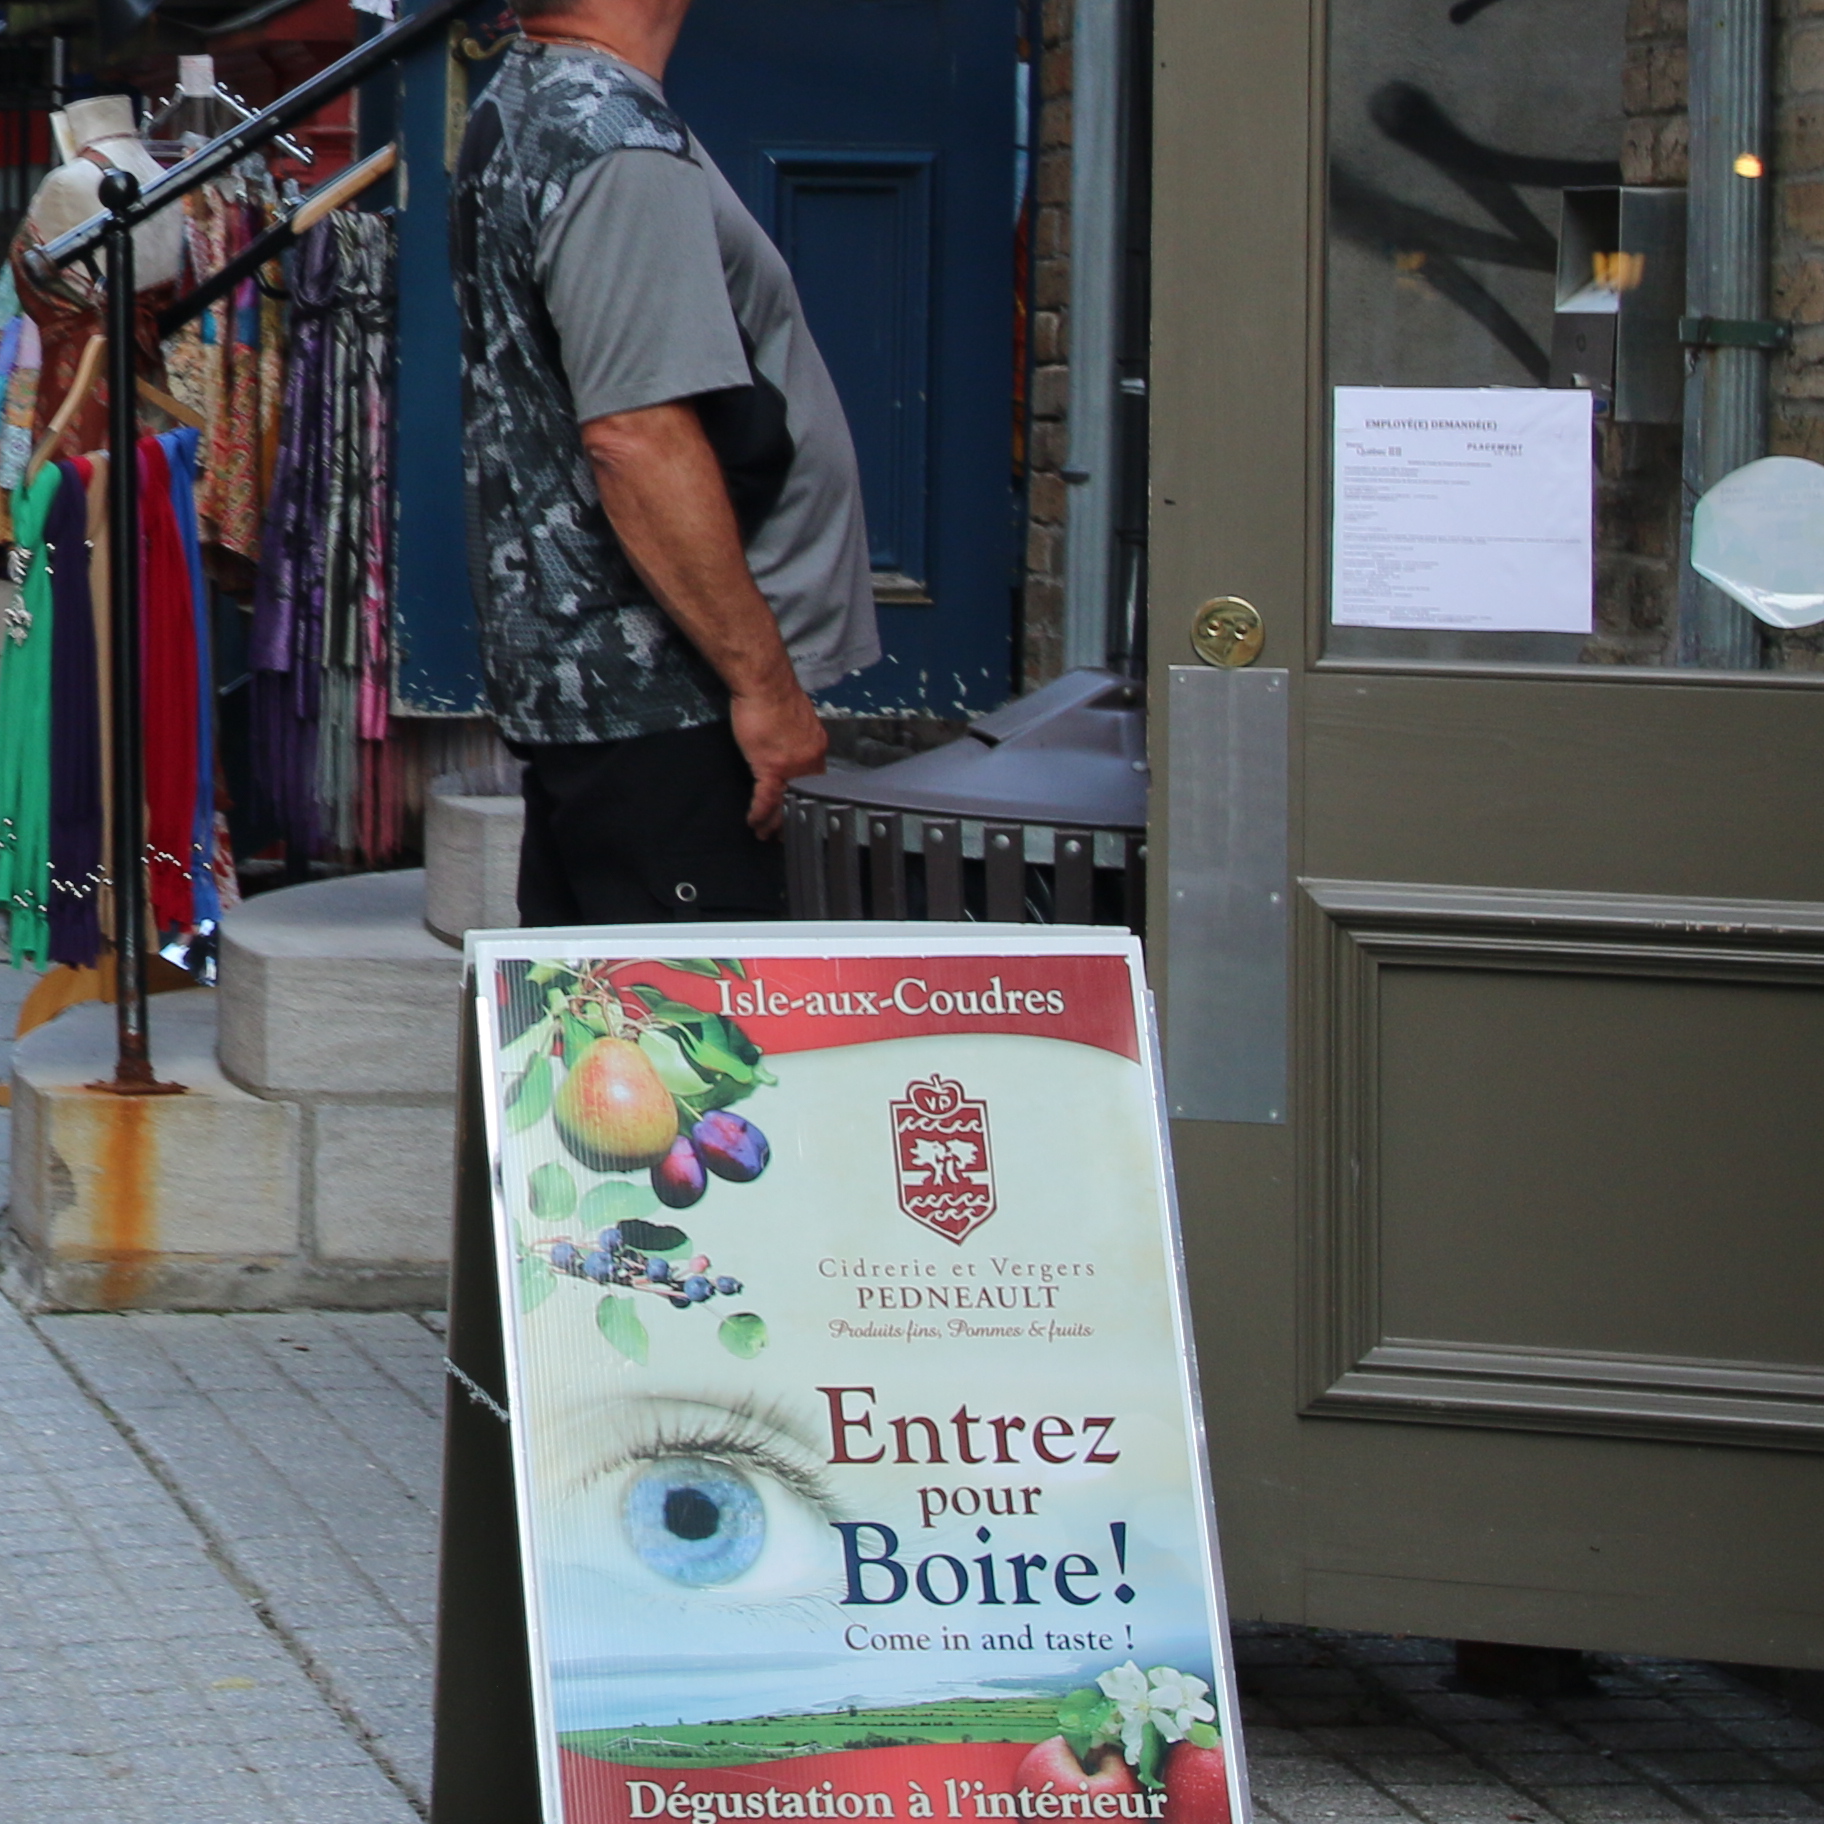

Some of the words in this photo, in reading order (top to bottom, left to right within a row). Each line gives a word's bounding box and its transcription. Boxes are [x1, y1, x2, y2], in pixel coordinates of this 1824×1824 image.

[715, 976, 1065, 1017] Isle-aux-Coudres
[818, 1257, 938, 1278] Cidrerie
[952, 1262, 977, 1277] et
[989, 1257, 1097, 1282] Vergers
[856, 1285, 1060, 1310] PEDNEAULT
[828, 1317, 903, 1339] Produits
[946, 1317, 1023, 1339] Pommes
[1046, 1318, 1096, 1343] fruits
[814, 1385, 1121, 1464] Entrez
[916, 1484, 1042, 1529] pour
[829, 1521, 1136, 1606] Boire!
[844, 1623, 931, 1651] Come
[941, 1625, 972, 1651] in
[981, 1623, 1035, 1651] and
[1045, 1630, 1113, 1651] taste
[624, 1779, 895, 1824] Dégustation
[907, 1782, 935, 1819] à
[945, 1778, 1169, 1819] l'intérieur
